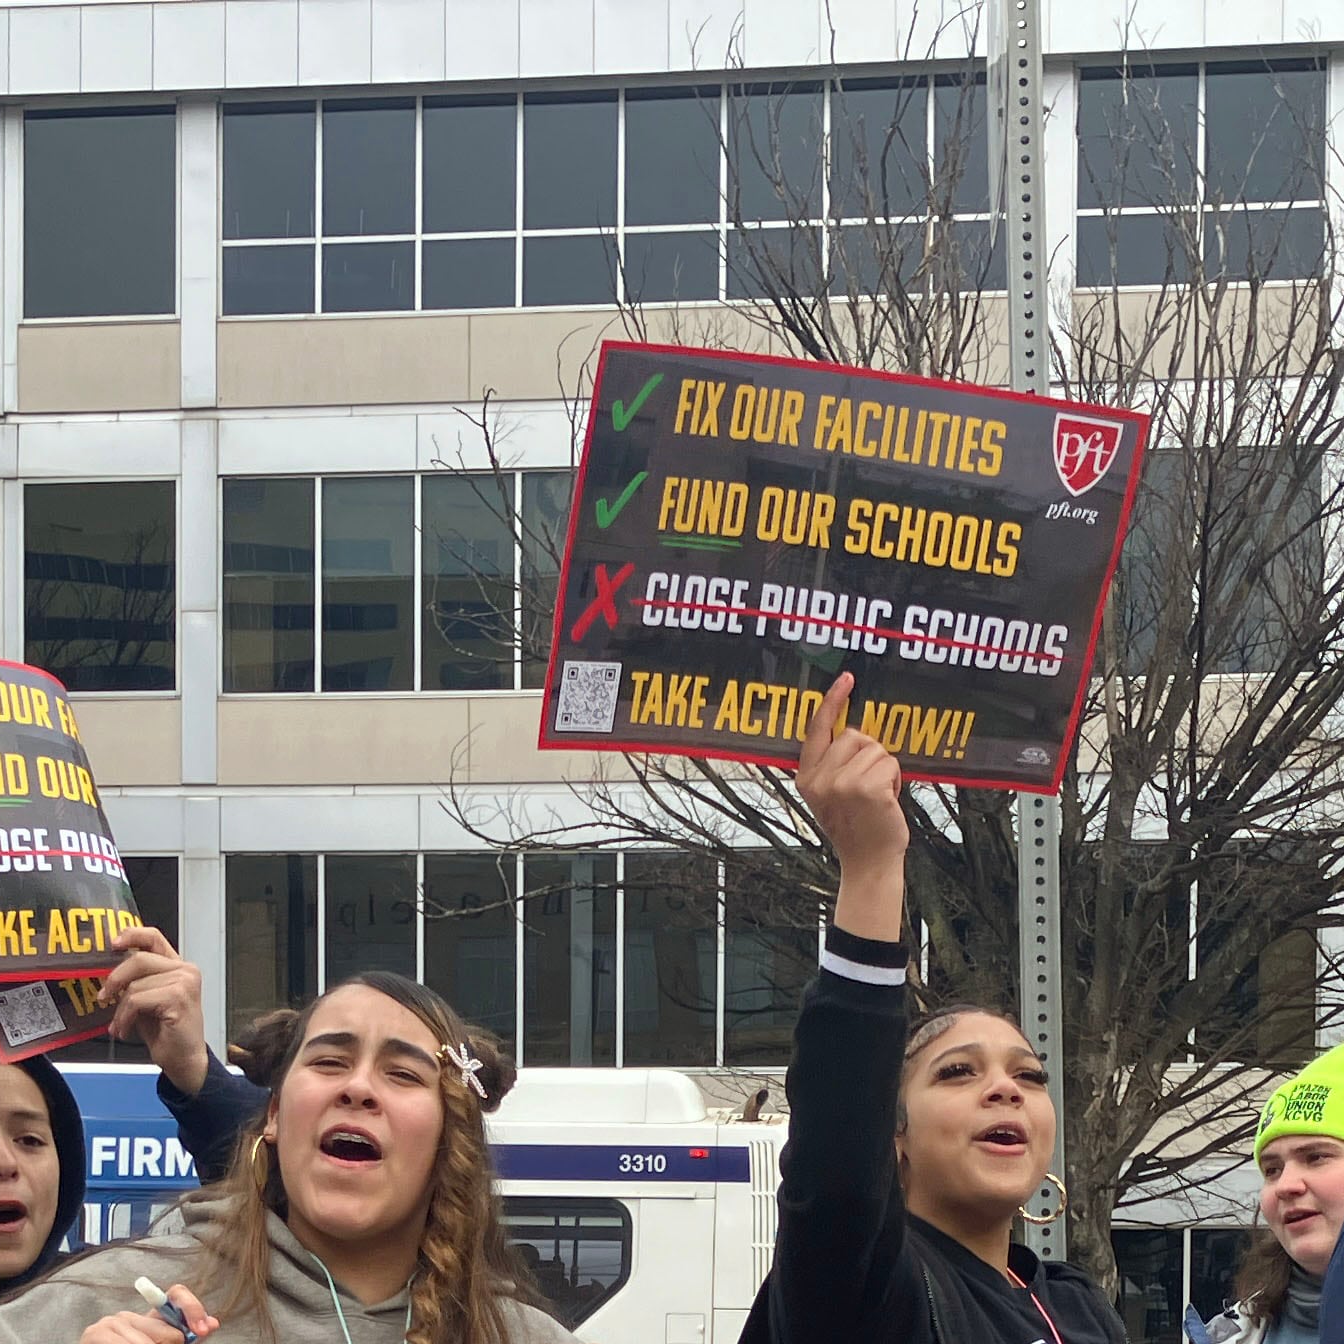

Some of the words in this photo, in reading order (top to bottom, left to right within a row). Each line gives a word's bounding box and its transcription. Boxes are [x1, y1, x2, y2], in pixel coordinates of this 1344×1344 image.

[673, 378, 728, 437] FIX
[728, 384, 806, 447] OUR
[813, 395, 1007, 477] FACILITIES
[1058, 428, 1110, 485] pft
[657, 476, 750, 537] FUND
[756, 486, 836, 550] OUR
[844, 498, 1023, 578] SCHOOLS
[1045, 501, 1099, 525] pft.org
[642, 572, 747, 635] CLOSE
[756, 581, 893, 655] PUBLIC
[898, 603, 1069, 677] SCHOOLS
[629, 670, 710, 729] TAKE
[860, 699, 976, 760] NOW!!
[36, 755, 98, 809] OUR
[47, 907, 145, 955] ACTI
[1287, 1100, 1326, 1112] UNION
[91, 1136, 198, 1177] FIRM
[618, 1154, 667, 1173] 3310
